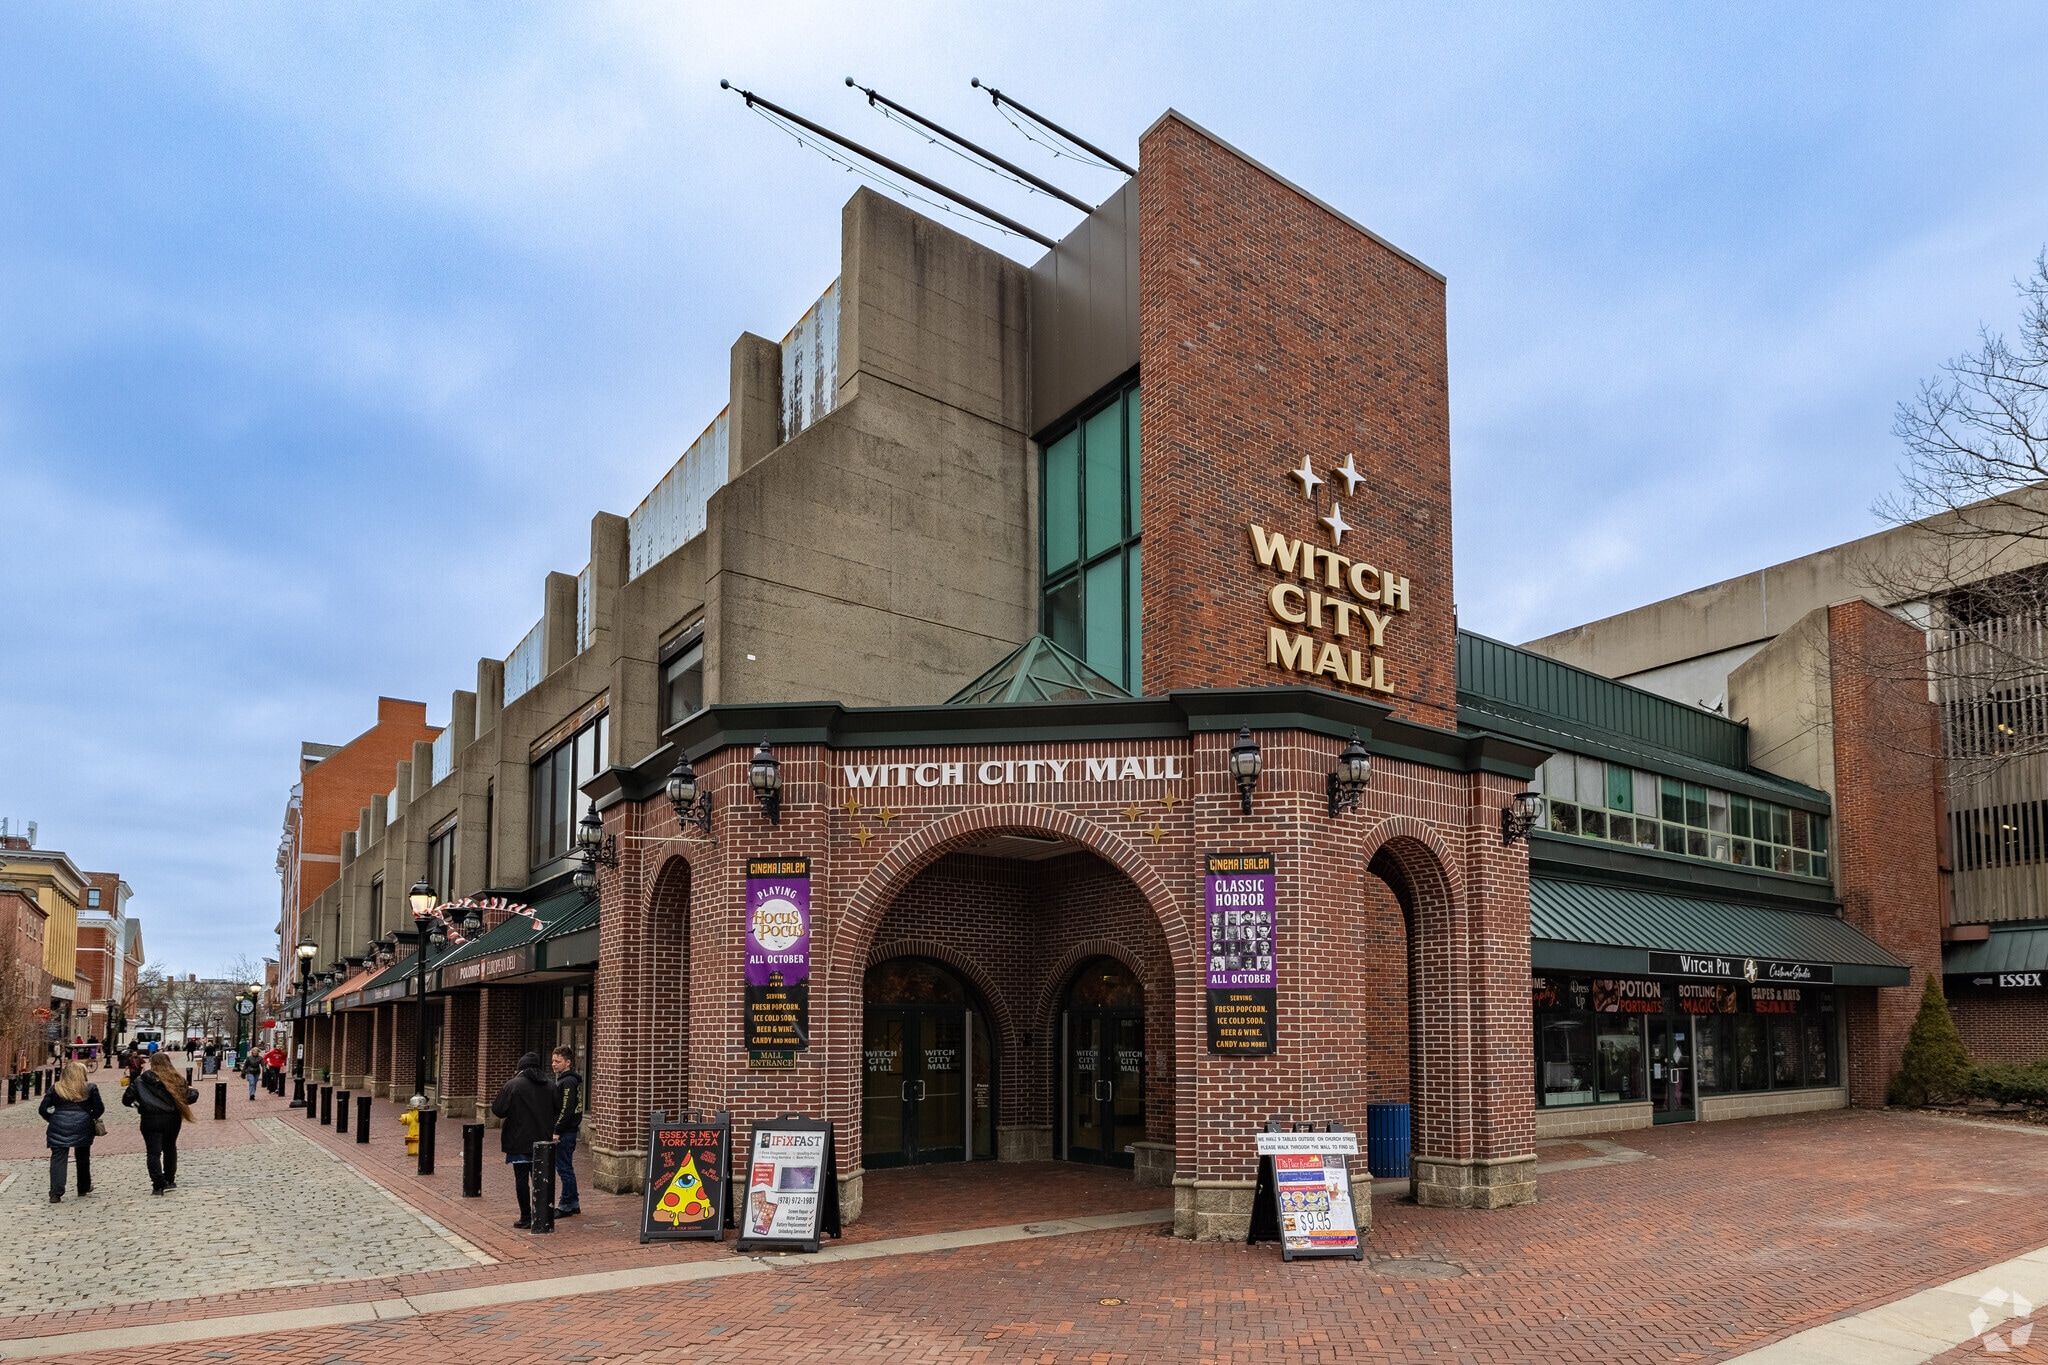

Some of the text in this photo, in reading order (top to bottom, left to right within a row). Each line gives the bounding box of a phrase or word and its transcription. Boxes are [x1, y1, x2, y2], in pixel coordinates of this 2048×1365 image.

[1248, 523, 1410, 612] WITCH
[1268, 583, 1392, 647] CITY
[1267, 626, 1394, 694] MALL
[844, 755, 1183, 788] WITCH CITY MALL
[1215, 879, 1265, 892] CLASSIC
[757, 886, 797, 899] PLAYING
[1215, 893, 1265, 906] HORROR
[750, 954, 804, 964] ALL OCTOBER
[1680, 955, 1731, 975] WITCH PIX
[1211, 974, 1271, 984] ALL OCTOBER
[1999, 973, 2042, 988] ESSEX
[1570, 980, 1589, 994] Dress
[1619, 979, 1661, 998] POTION
[1679, 985, 1715, 998] BOTTLING
[1751, 987, 1800, 1001] CAPES & HATS
[1620, 1000, 1663, 1013] PORTRAITS
[1683, 999, 1714, 1014] MAGIC
[1755, 1000, 1797, 1013] SALE
[1220, 1028, 1236, 1036] BEER
[750, 1059, 794, 1067] ENTRANCE
[700, 1130, 721, 1138] NEW
[660, 1138, 718, 1147] YORK PIZZA
[1300, 1211, 1332, 1231] $9.95
